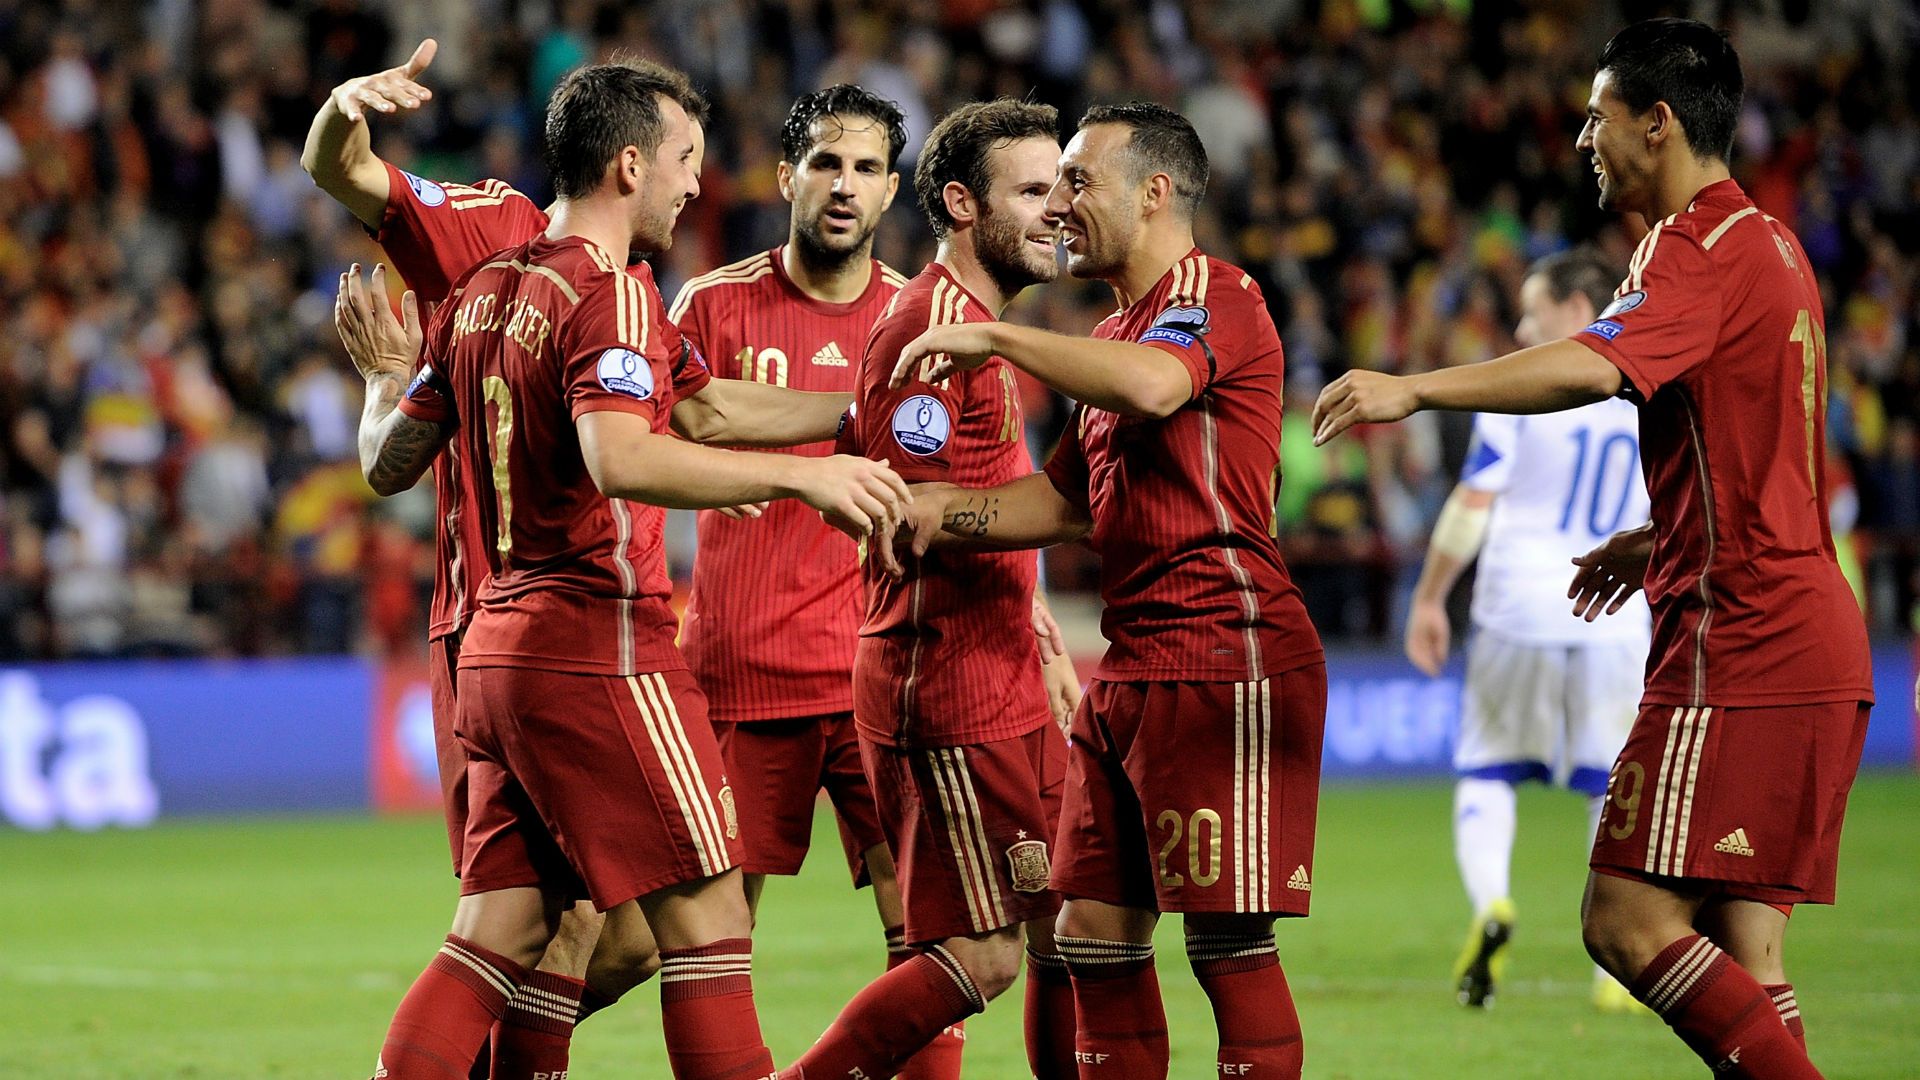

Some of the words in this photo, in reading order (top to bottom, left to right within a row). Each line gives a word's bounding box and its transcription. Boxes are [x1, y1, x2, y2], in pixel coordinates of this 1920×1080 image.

[453, 293, 497, 346] PACO
[811, 356, 849, 367] adidas
[1558, 427, 1638, 536] 10
[1156, 807, 1222, 887] 20
[1714, 842, 1755, 857] adidas
